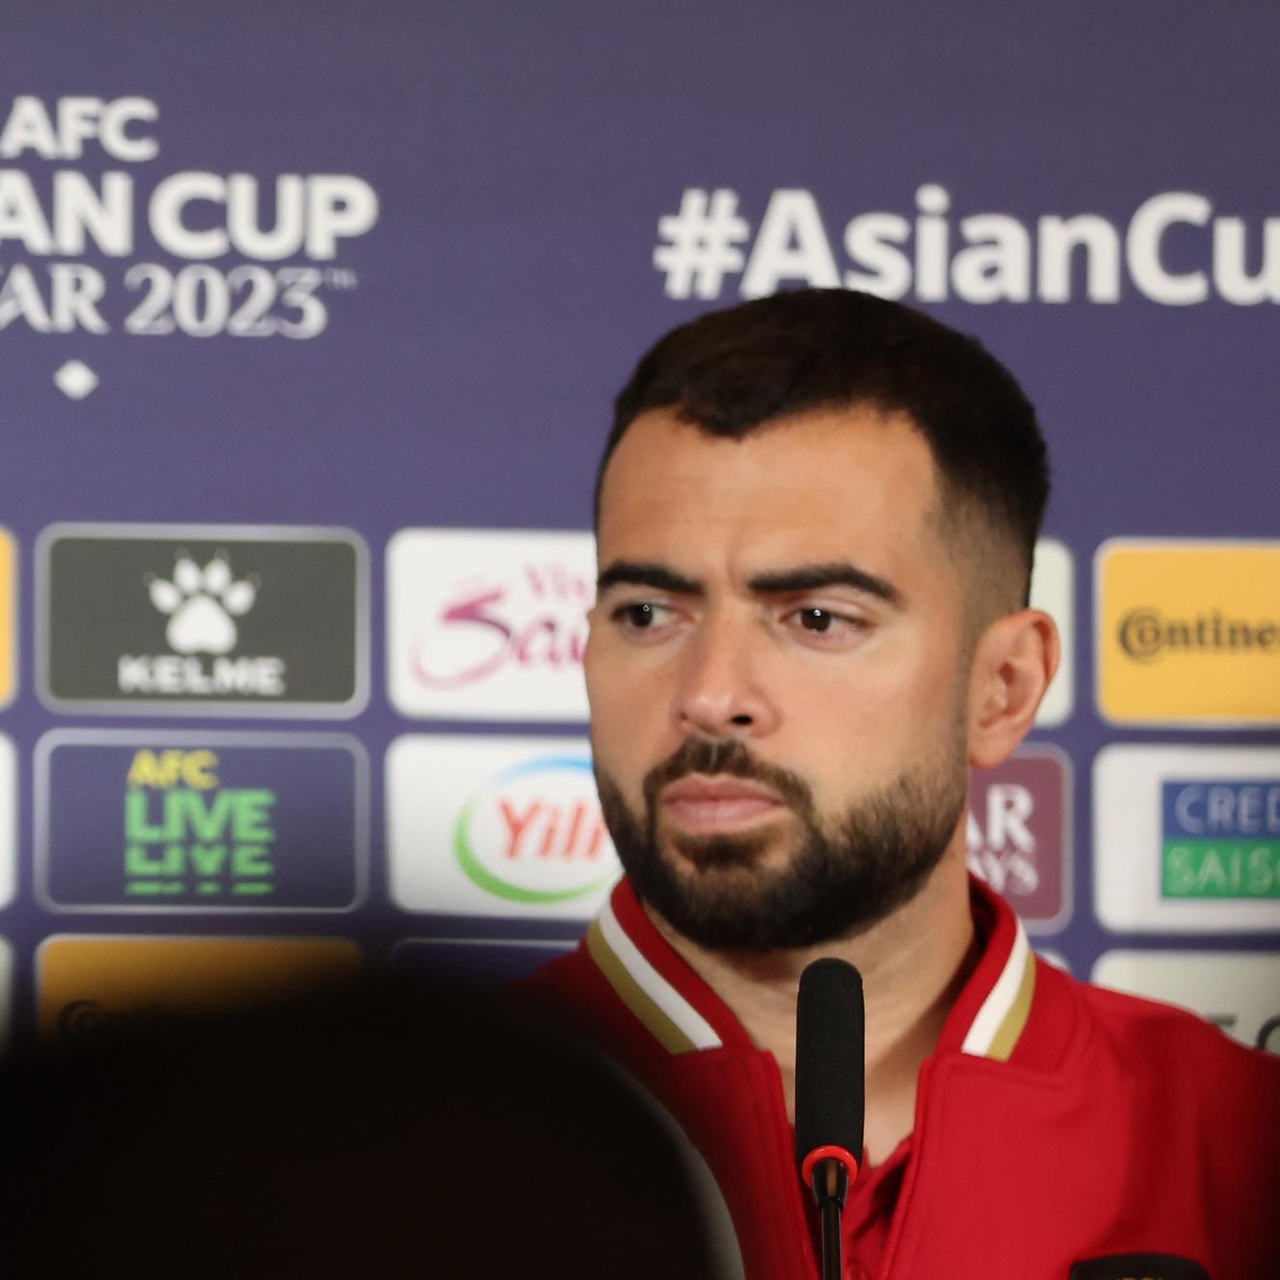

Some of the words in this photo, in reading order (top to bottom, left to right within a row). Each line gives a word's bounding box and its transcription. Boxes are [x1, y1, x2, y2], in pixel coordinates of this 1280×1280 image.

[148, 172, 379, 261] CUP
[124, 263, 329, 340] 2023
[115, 654, 286, 697] KELME
[127, 749, 220, 789] AFC
[124, 788, 276, 845] LIVE
[1167, 840, 1280, 896] SAIS
